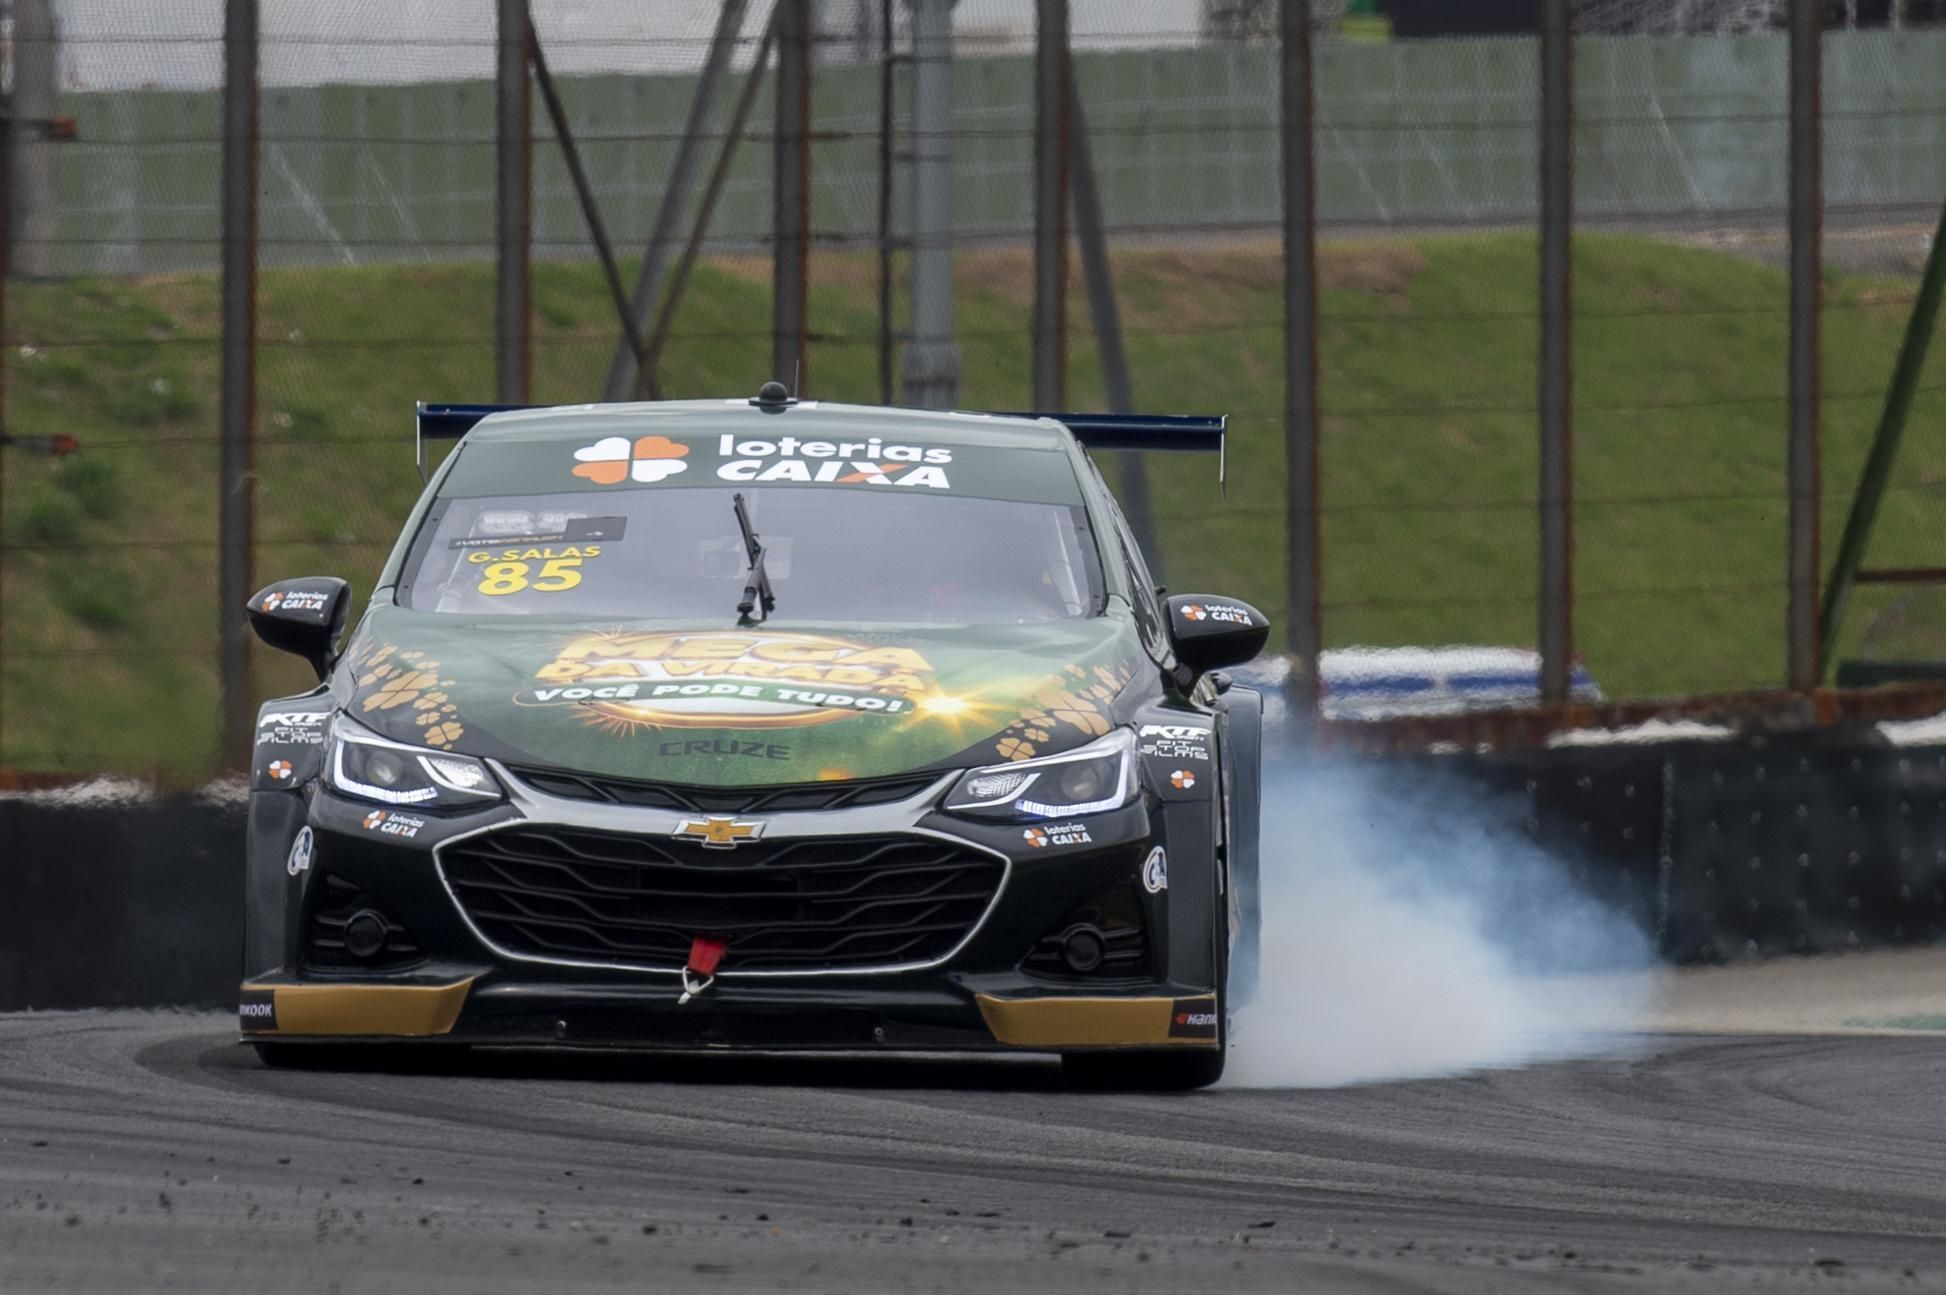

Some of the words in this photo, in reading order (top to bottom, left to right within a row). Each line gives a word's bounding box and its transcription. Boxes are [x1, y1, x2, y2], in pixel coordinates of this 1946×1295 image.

[719, 434, 953, 464] loterias
[716, 459, 950, 489] CAIXA
[467, 545, 601, 565] G.SALAS
[478, 558, 583, 596] 85
[281, 599, 323, 610] CAIXA
[1211, 611, 1253, 626] CAIXA
[534, 683, 640, 702] VOCÊ
[652, 684, 762, 698] PODE
[778, 688, 904, 712] TUDO!
[658, 739, 792, 761] CRUZE
[381, 822, 418, 838] CAIXA
[1043, 822, 1087, 835] loterias
[1052, 832, 1093, 845] CAIXA
